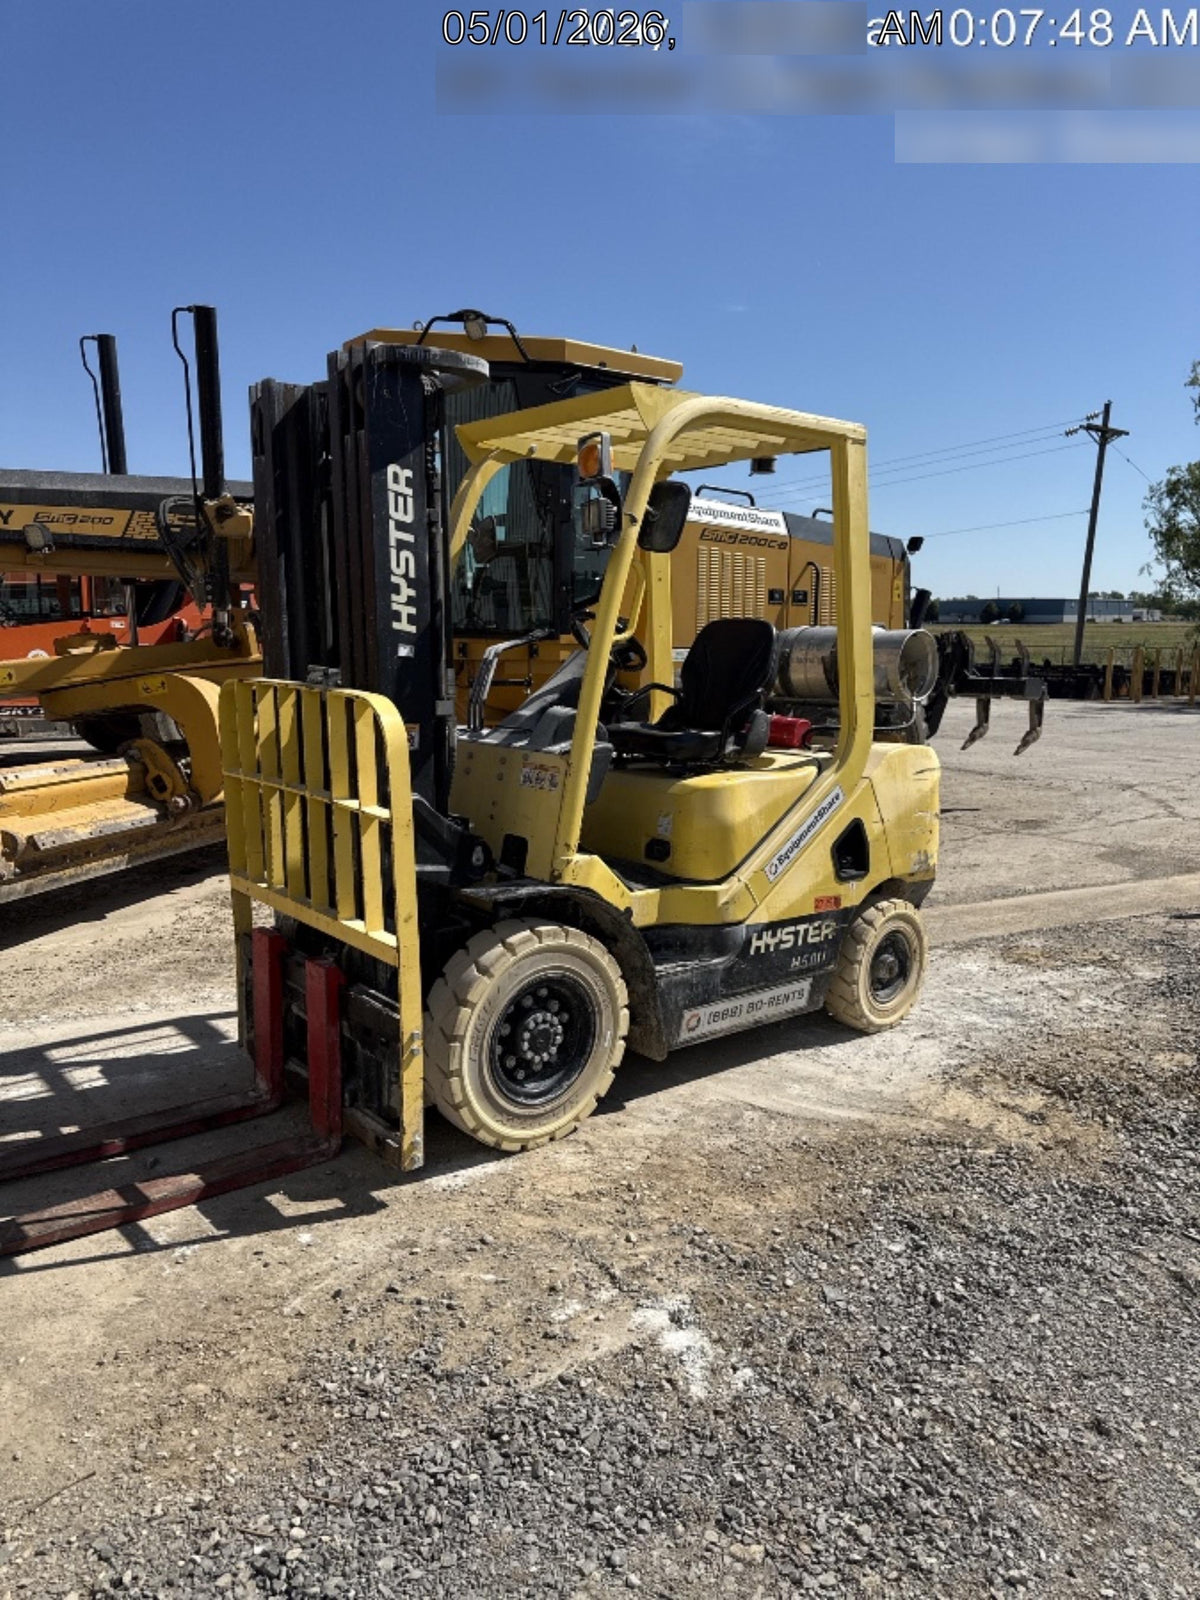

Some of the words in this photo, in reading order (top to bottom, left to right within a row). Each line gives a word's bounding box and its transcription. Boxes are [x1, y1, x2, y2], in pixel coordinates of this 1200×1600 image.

[387, 463, 417, 634] HYSTER
[776, 792, 840, 866] EquipmentShare
[749, 920, 837, 955] HYSTER
